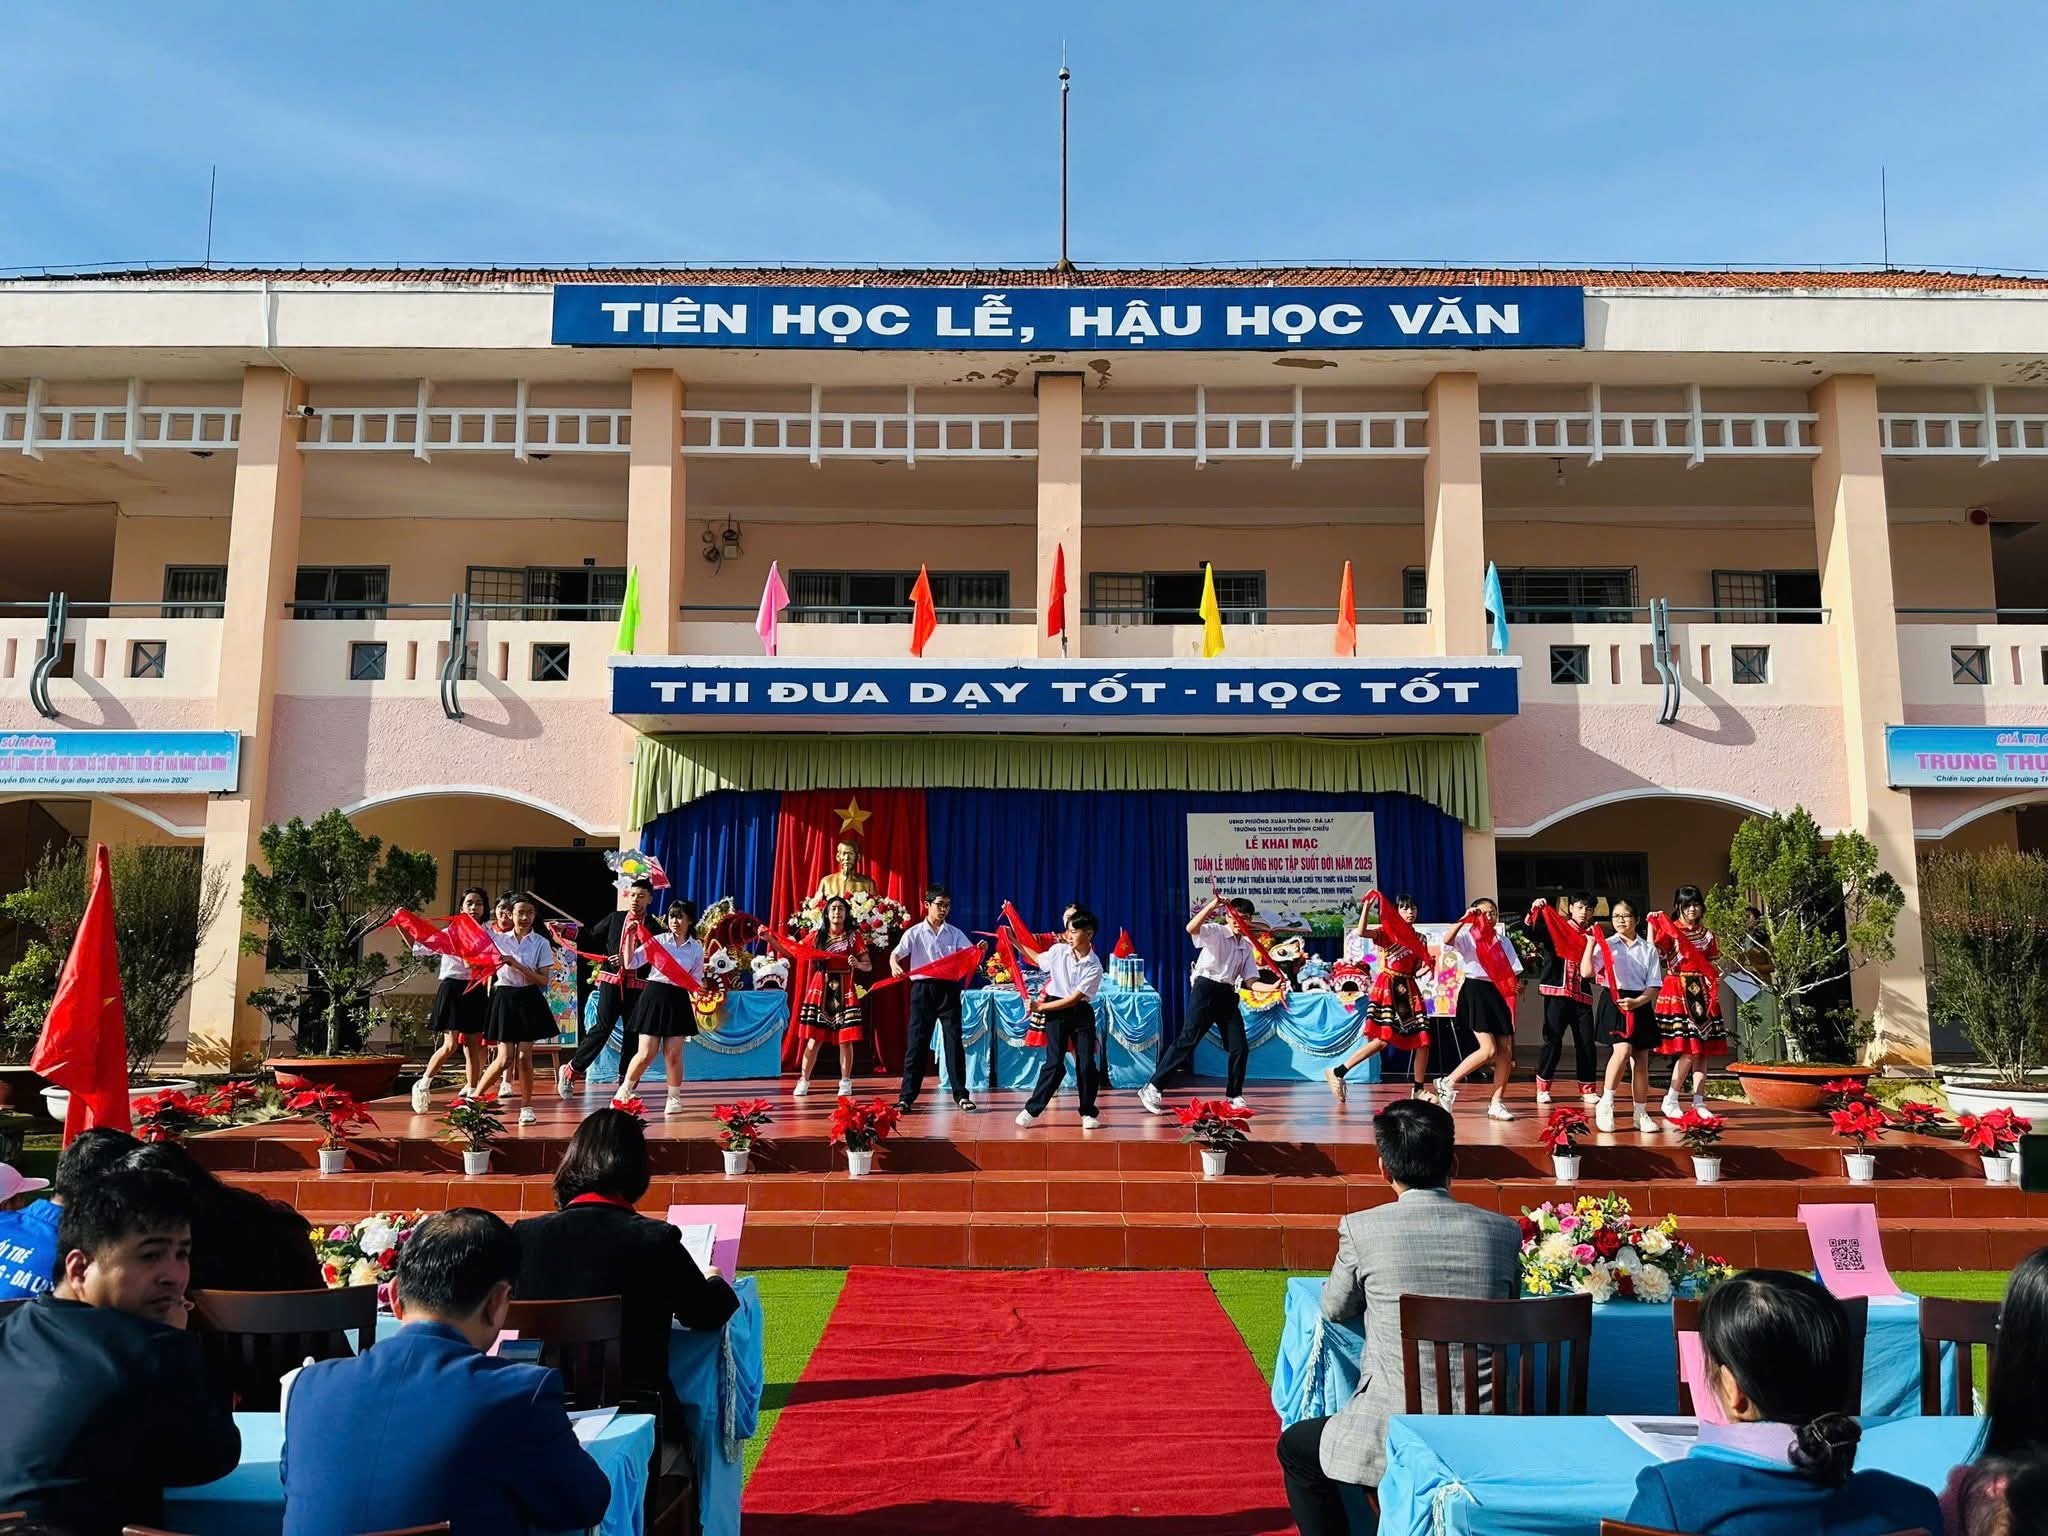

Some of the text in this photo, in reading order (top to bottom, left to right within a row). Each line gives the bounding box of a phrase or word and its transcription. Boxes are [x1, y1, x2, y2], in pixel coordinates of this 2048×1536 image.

[602, 294, 1520, 344] TIÊN HỌC LỄ, HẬU HỌC VĂN
[651, 682, 749, 703] THI
[767, 682, 889, 703] ĐUA
[910, 682, 1029, 709] DẠY
[1052, 673, 1166, 703] TỐT
[1216, 682, 1341, 709] HỌC
[1361, 672, 1480, 703] TỐT
[1916, 752, 1998, 771] TRUNG
[1262, 838, 1289, 849] KHAI
[1292, 838, 1318, 851] MẠC
[1268, 857, 1284, 873] HỌC
[1284, 855, 1298, 873] TẬP
[1301, 853, 1319, 871] SUỐT
[1335, 855, 1353, 871] NĂM
[1355, 857, 1373, 870] 2025
